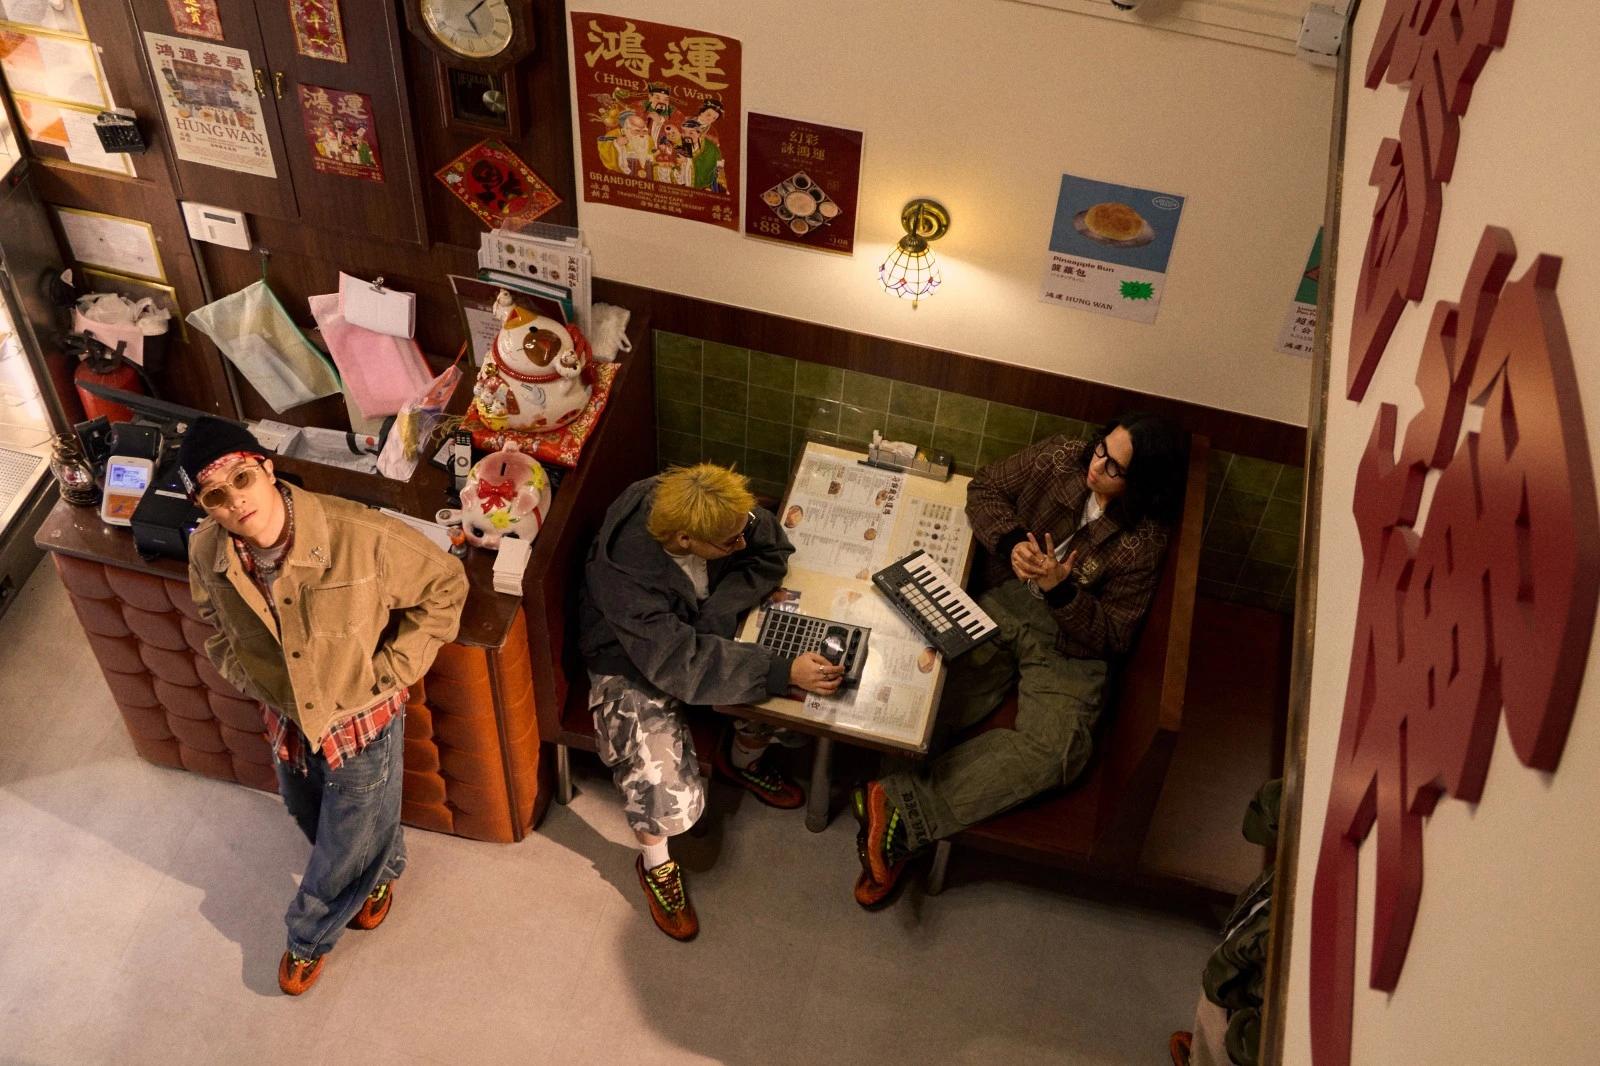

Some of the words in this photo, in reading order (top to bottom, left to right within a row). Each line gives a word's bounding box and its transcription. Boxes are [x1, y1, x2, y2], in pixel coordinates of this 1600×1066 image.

[155, 42, 245, 71] 鴻運美學
[584, 19, 730, 91] 鴻運
[302, 87, 368, 120] 鴻運
[175, 117, 223, 137] HUNG
[226, 127, 264, 146] WAN
[789, 130, 819, 146] 幻彩
[781, 142, 826, 161] 詠鴻運
[589, 171, 624, 186] GRAND
[625, 177, 655, 191] OPEN!
[1051, 263, 1087, 278] 菠蘿包
[1053, 255, 1096, 269] Pineapple
[1096, 264, 1115, 273] Bun
[1066, 295, 1091, 307] HUNG
[1093, 301, 1113, 310] WAN
